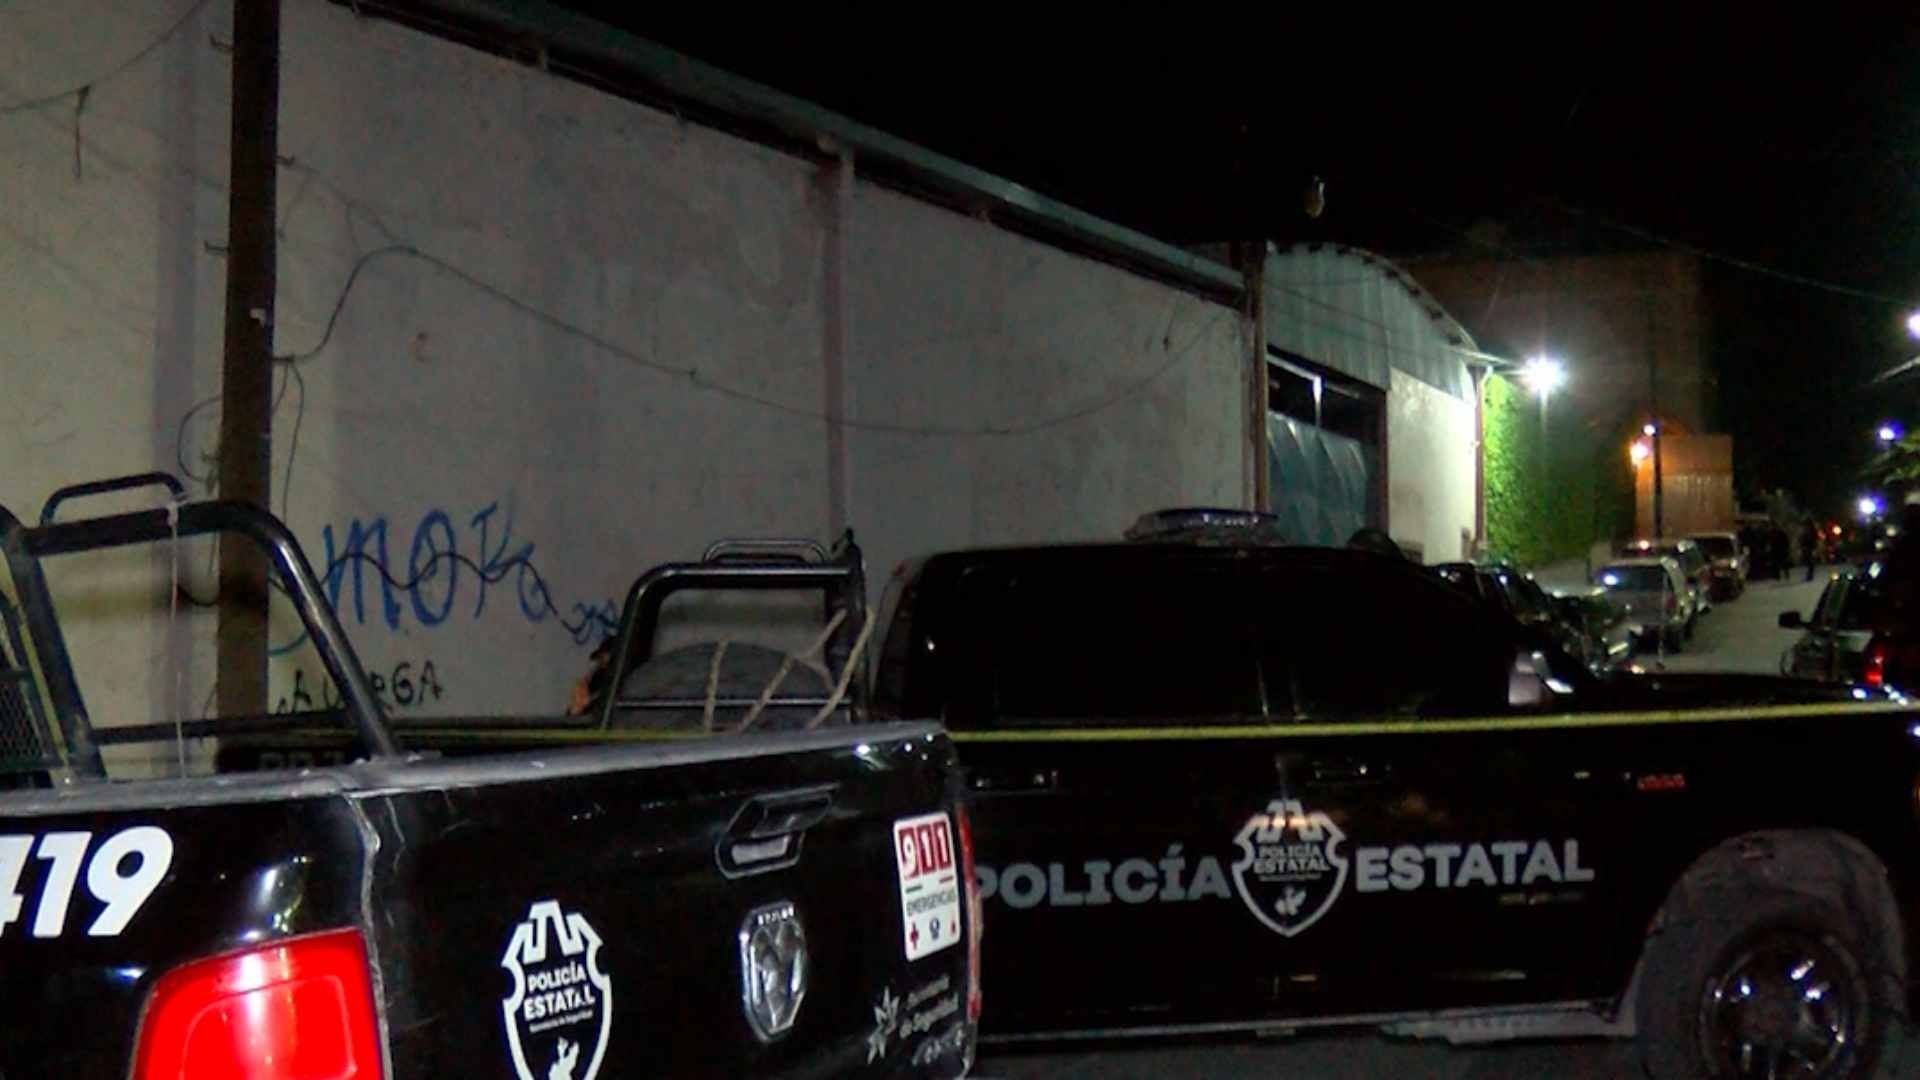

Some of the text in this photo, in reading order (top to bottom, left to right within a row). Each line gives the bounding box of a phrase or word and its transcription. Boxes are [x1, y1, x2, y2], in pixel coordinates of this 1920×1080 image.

[901, 826, 950, 877] 911
[1253, 858, 1332, 874] ESTATAL
[1355, 837, 1596, 894] ESTATAL
[527, 960, 587, 993] POLICÍA
[523, 983, 596, 1022] ESTATAL
